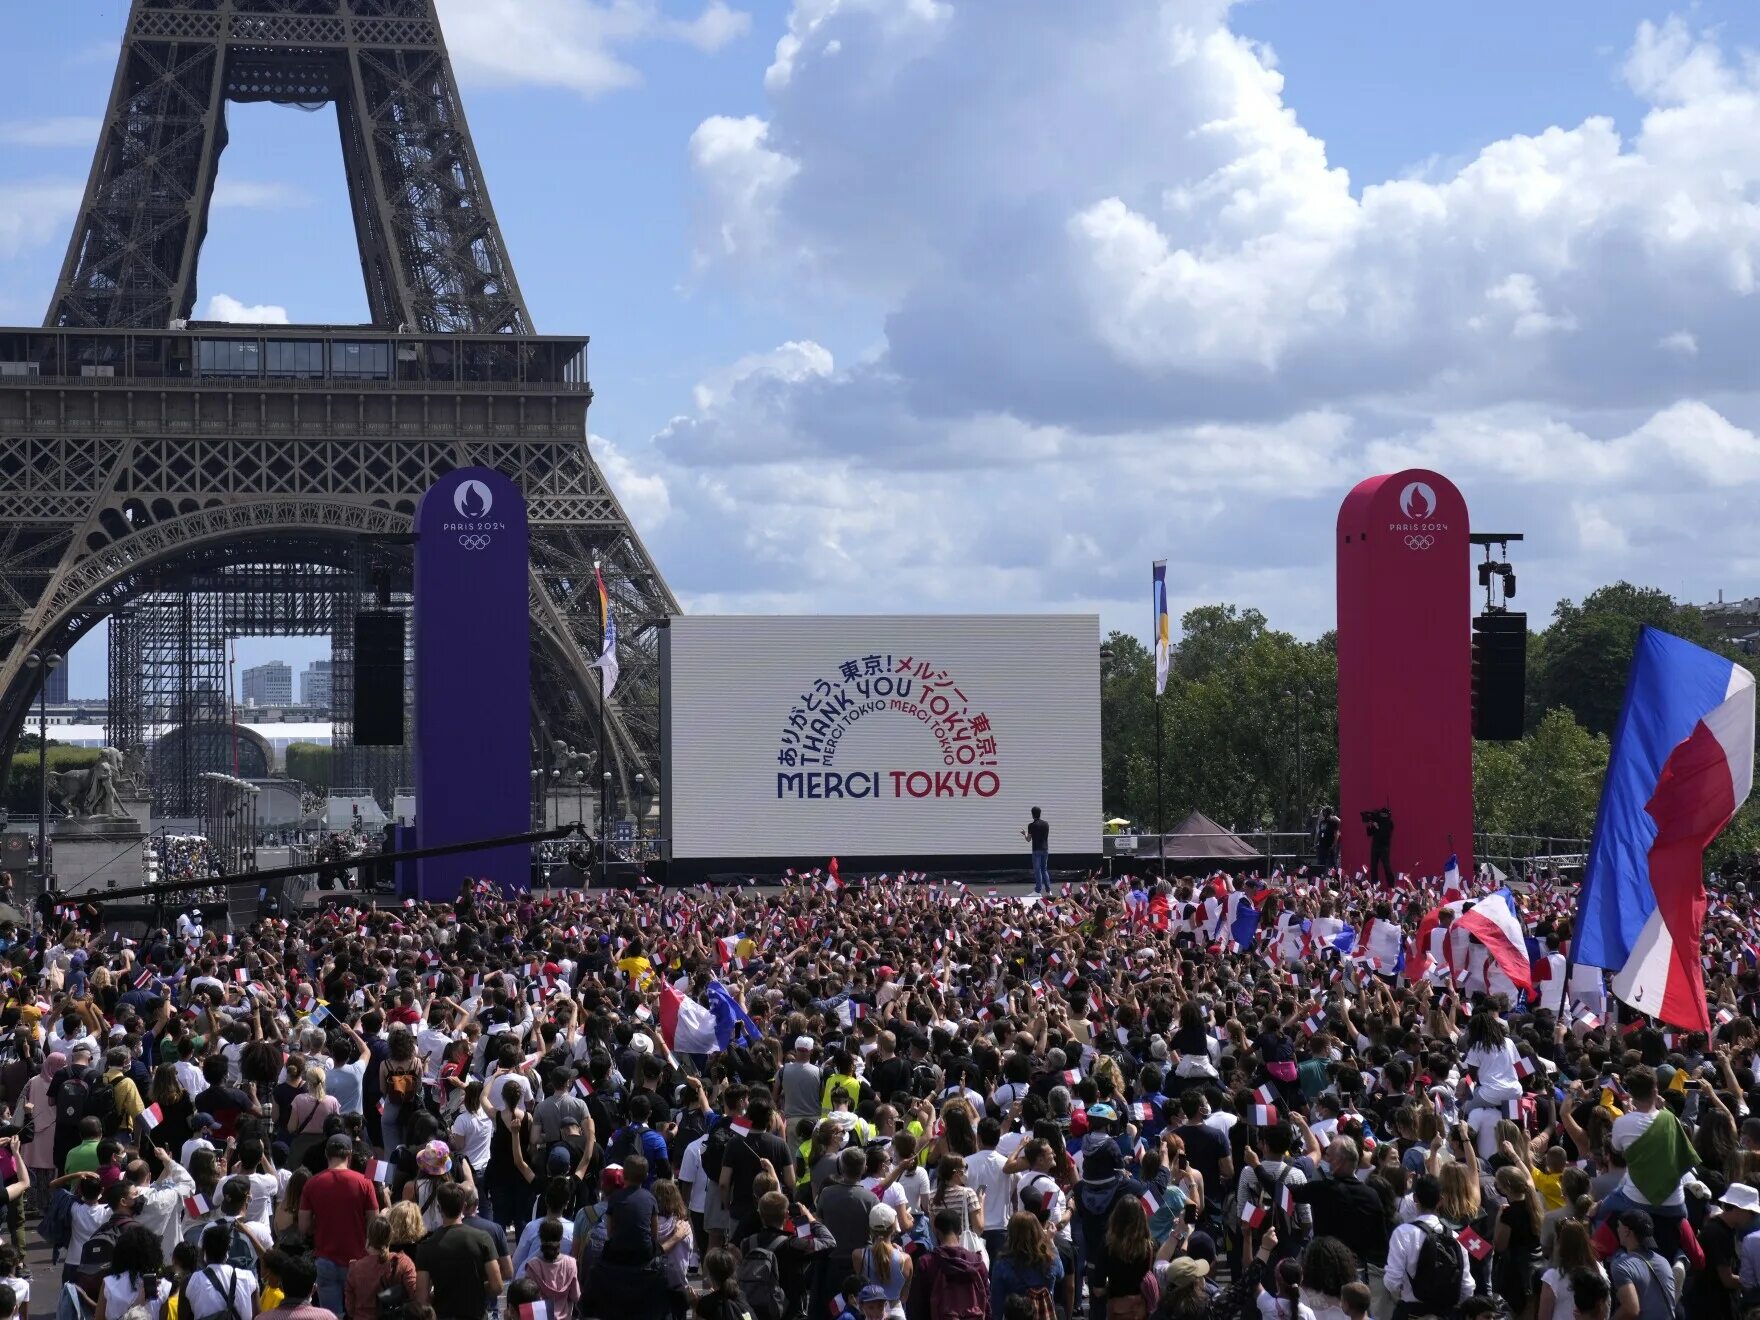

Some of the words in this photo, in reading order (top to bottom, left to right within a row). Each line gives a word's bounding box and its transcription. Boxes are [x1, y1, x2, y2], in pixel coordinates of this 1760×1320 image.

[443, 523, 474, 531] PARIS
[477, 522, 505, 530] 2024
[1389, 523, 1419, 531] PARIS
[1421, 523, 1448, 531] 2024
[800, 688, 855, 766] THANK
[856, 676, 912, 699] YOU
[919, 684, 976, 765] TOKYO
[822, 723, 846, 767] MERCI
[841, 699, 886, 726] TOKYO
[890, 699, 932, 724] MERCI
[930, 720, 955, 766] TOKYO
[777, 771, 879, 799] MERCI
[889, 770, 1000, 798] TOKYO
